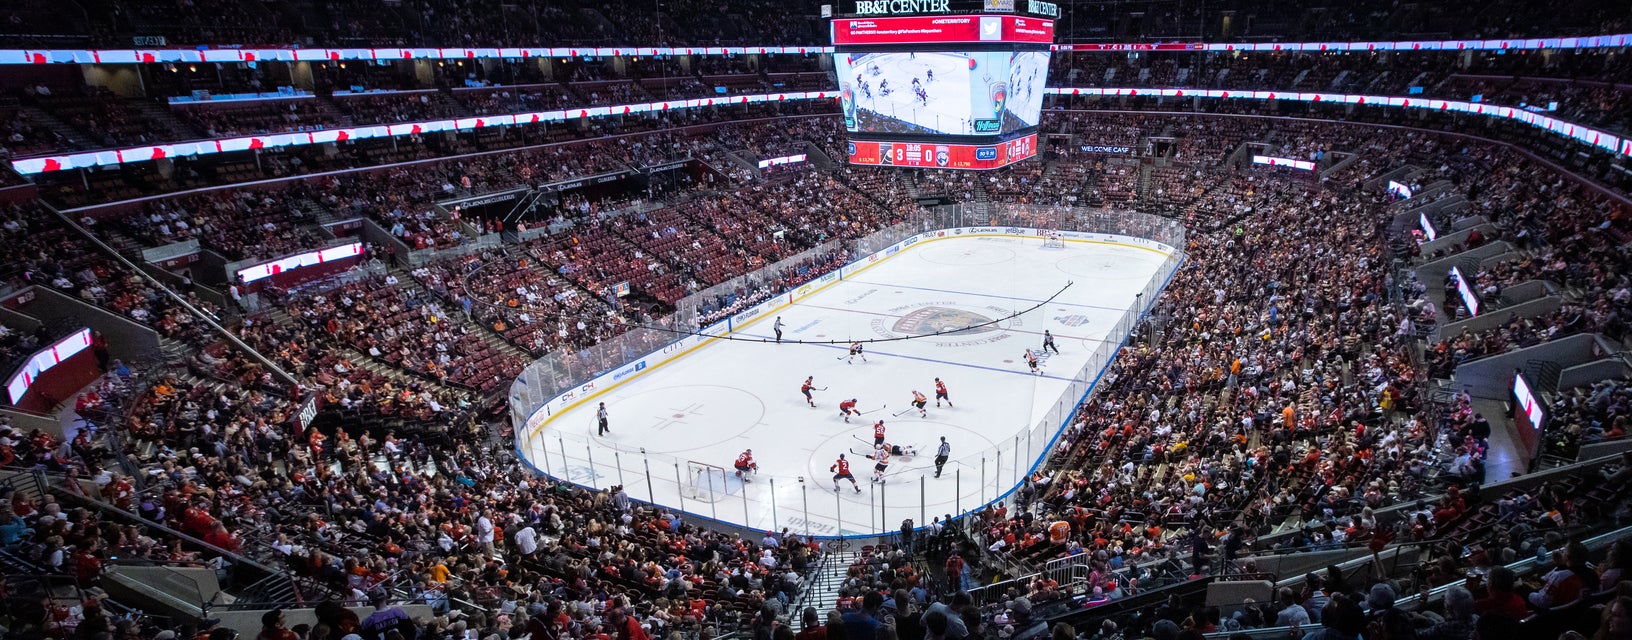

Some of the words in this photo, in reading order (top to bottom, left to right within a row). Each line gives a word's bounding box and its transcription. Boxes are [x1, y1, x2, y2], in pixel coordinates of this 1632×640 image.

[856, 1, 890, 14] BB&T
[890, 0, 951, 13] CENTER
[1039, 2, 1057, 16] CENTER
[896, 148, 903, 161] 3
[925, 149, 933, 162] 0
[1005, 226, 1026, 235] jetBlue
[903, 236, 918, 247] GEICO
[663, 341, 684, 354] CITY
[299, 397, 318, 432] BB&T
[842, 462, 848, 470] 2
